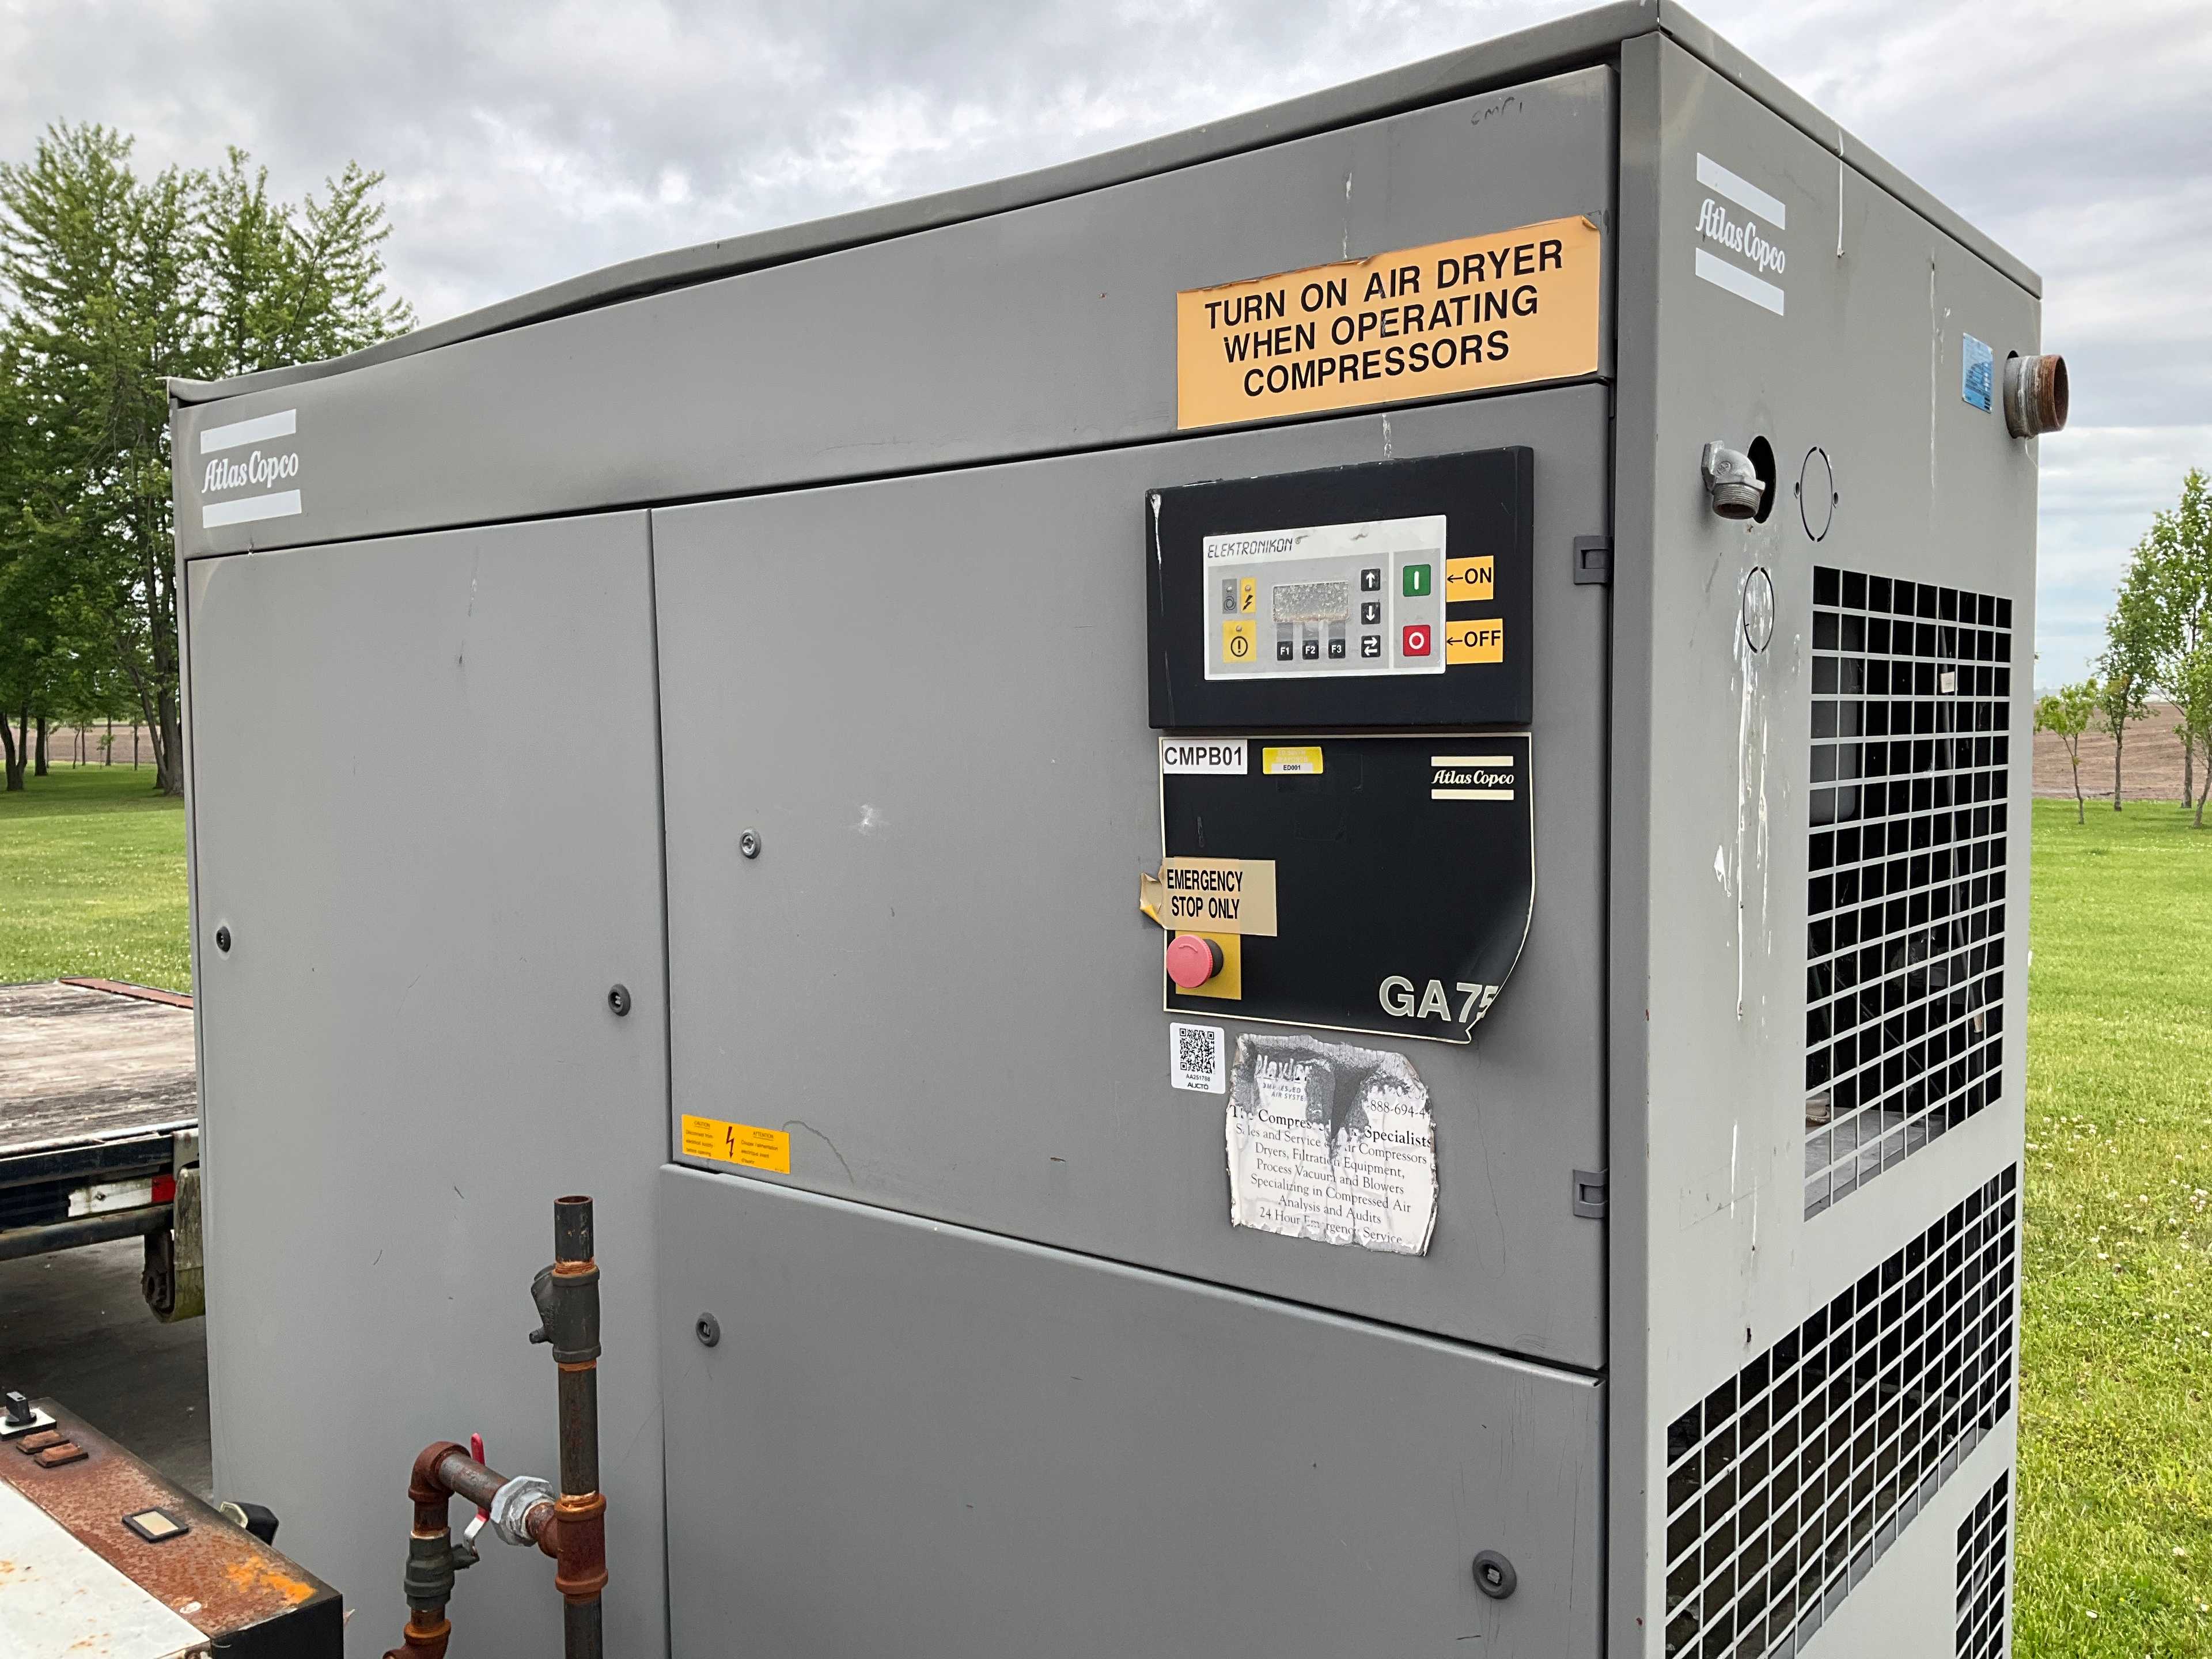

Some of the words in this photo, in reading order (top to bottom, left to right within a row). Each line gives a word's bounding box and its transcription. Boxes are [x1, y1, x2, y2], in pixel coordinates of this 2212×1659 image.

[1696, 198, 1743, 252] Atlas
[1744, 222, 1785, 274] Copco
[1205, 290, 1285, 329] TURN
[1301, 278, 1347, 313] ON
[1363, 265, 1420, 302] AIR
[1437, 238, 1563, 290] DRYER
[1224, 321, 1315, 363] WHEN
[1331, 285, 1538, 344] OPERATING
[1244, 330, 1510, 397] COMPRESSORS
[202, 458, 247, 493] Atlas
[248, 450, 299, 488] Copco
[1464, 567, 1492, 584] ON
[1280, 647, 1290, 655] F1
[1305, 646, 1316, 654] F2
[1331, 645, 1342, 653] F3
[1464, 630, 1501, 647] OFF
[1164, 747, 1241, 766] CMPB01
[1431, 770, 1472, 784] Atlas
[1474, 770, 1514, 787] Copco
[1167, 869, 1243, 892] EMERGENCY
[1172, 895, 1203, 917] STOP
[1209, 897, 1240, 919] ONLY
[1285, 1093, 1306, 1101] SYSTE
[1255, 1142, 1290, 1159] Dryers,
[1344, 1157, 1405, 1179] Equipment,
[1263, 1130, 1281, 1141] and
[1285, 1130, 1320, 1147] Service
[1359, 1143, 1427, 1164] Compressors
[1257, 1158, 1292, 1175] Process
[1296, 1165, 1336, 1183] Vacuum
[1340, 1175, 1358, 1187] and
[1363, 1176, 1404, 1195] Blowers
[1251, 1173, 1309, 1196] Specializing
[1313, 1185, 1323, 1196] in
[1326, 1187, 1388, 1209] Compressed
[1393, 1199, 1411, 1213] Air
[1278, 1195, 1320, 1213] Analysis
[1323, 1205, 1342, 1217] and
[1346, 1207, 1382, 1224] Audits
[1260, 1206, 1271, 1219] 24
[1275, 1209, 1300, 1225] Hour
[1363, 1226, 1403, 1243] Service
